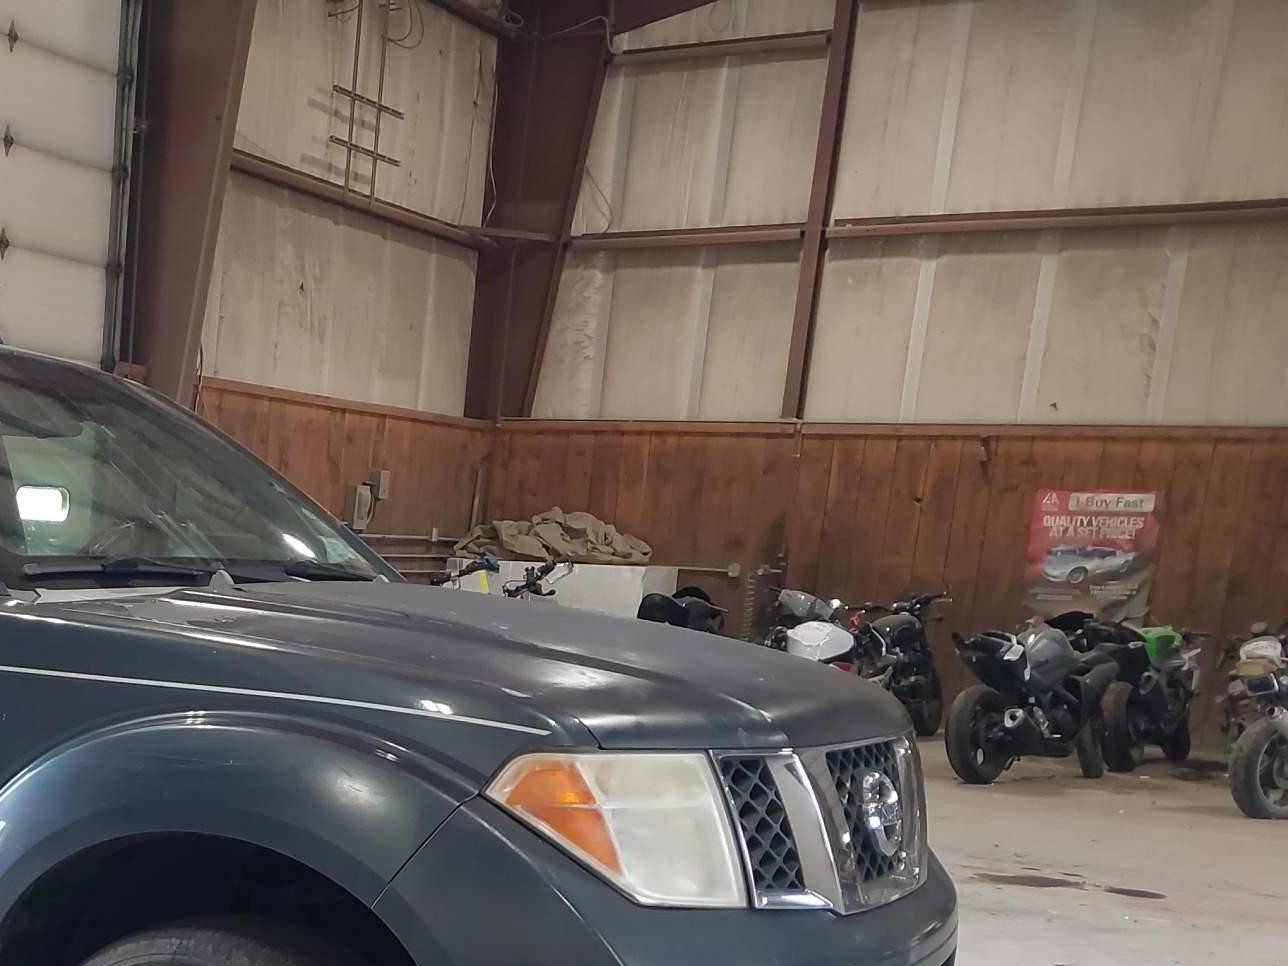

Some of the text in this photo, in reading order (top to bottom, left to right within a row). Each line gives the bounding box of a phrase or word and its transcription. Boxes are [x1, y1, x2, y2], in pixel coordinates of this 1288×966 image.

[1116, 496, 1144, 509] Fast
[1043, 515, 1145, 529] QUALITY VEHICLES
[1049, 526, 1065, 537] AT
[1066, 526, 1075, 537] A
[1077, 526, 1099, 538] SET
